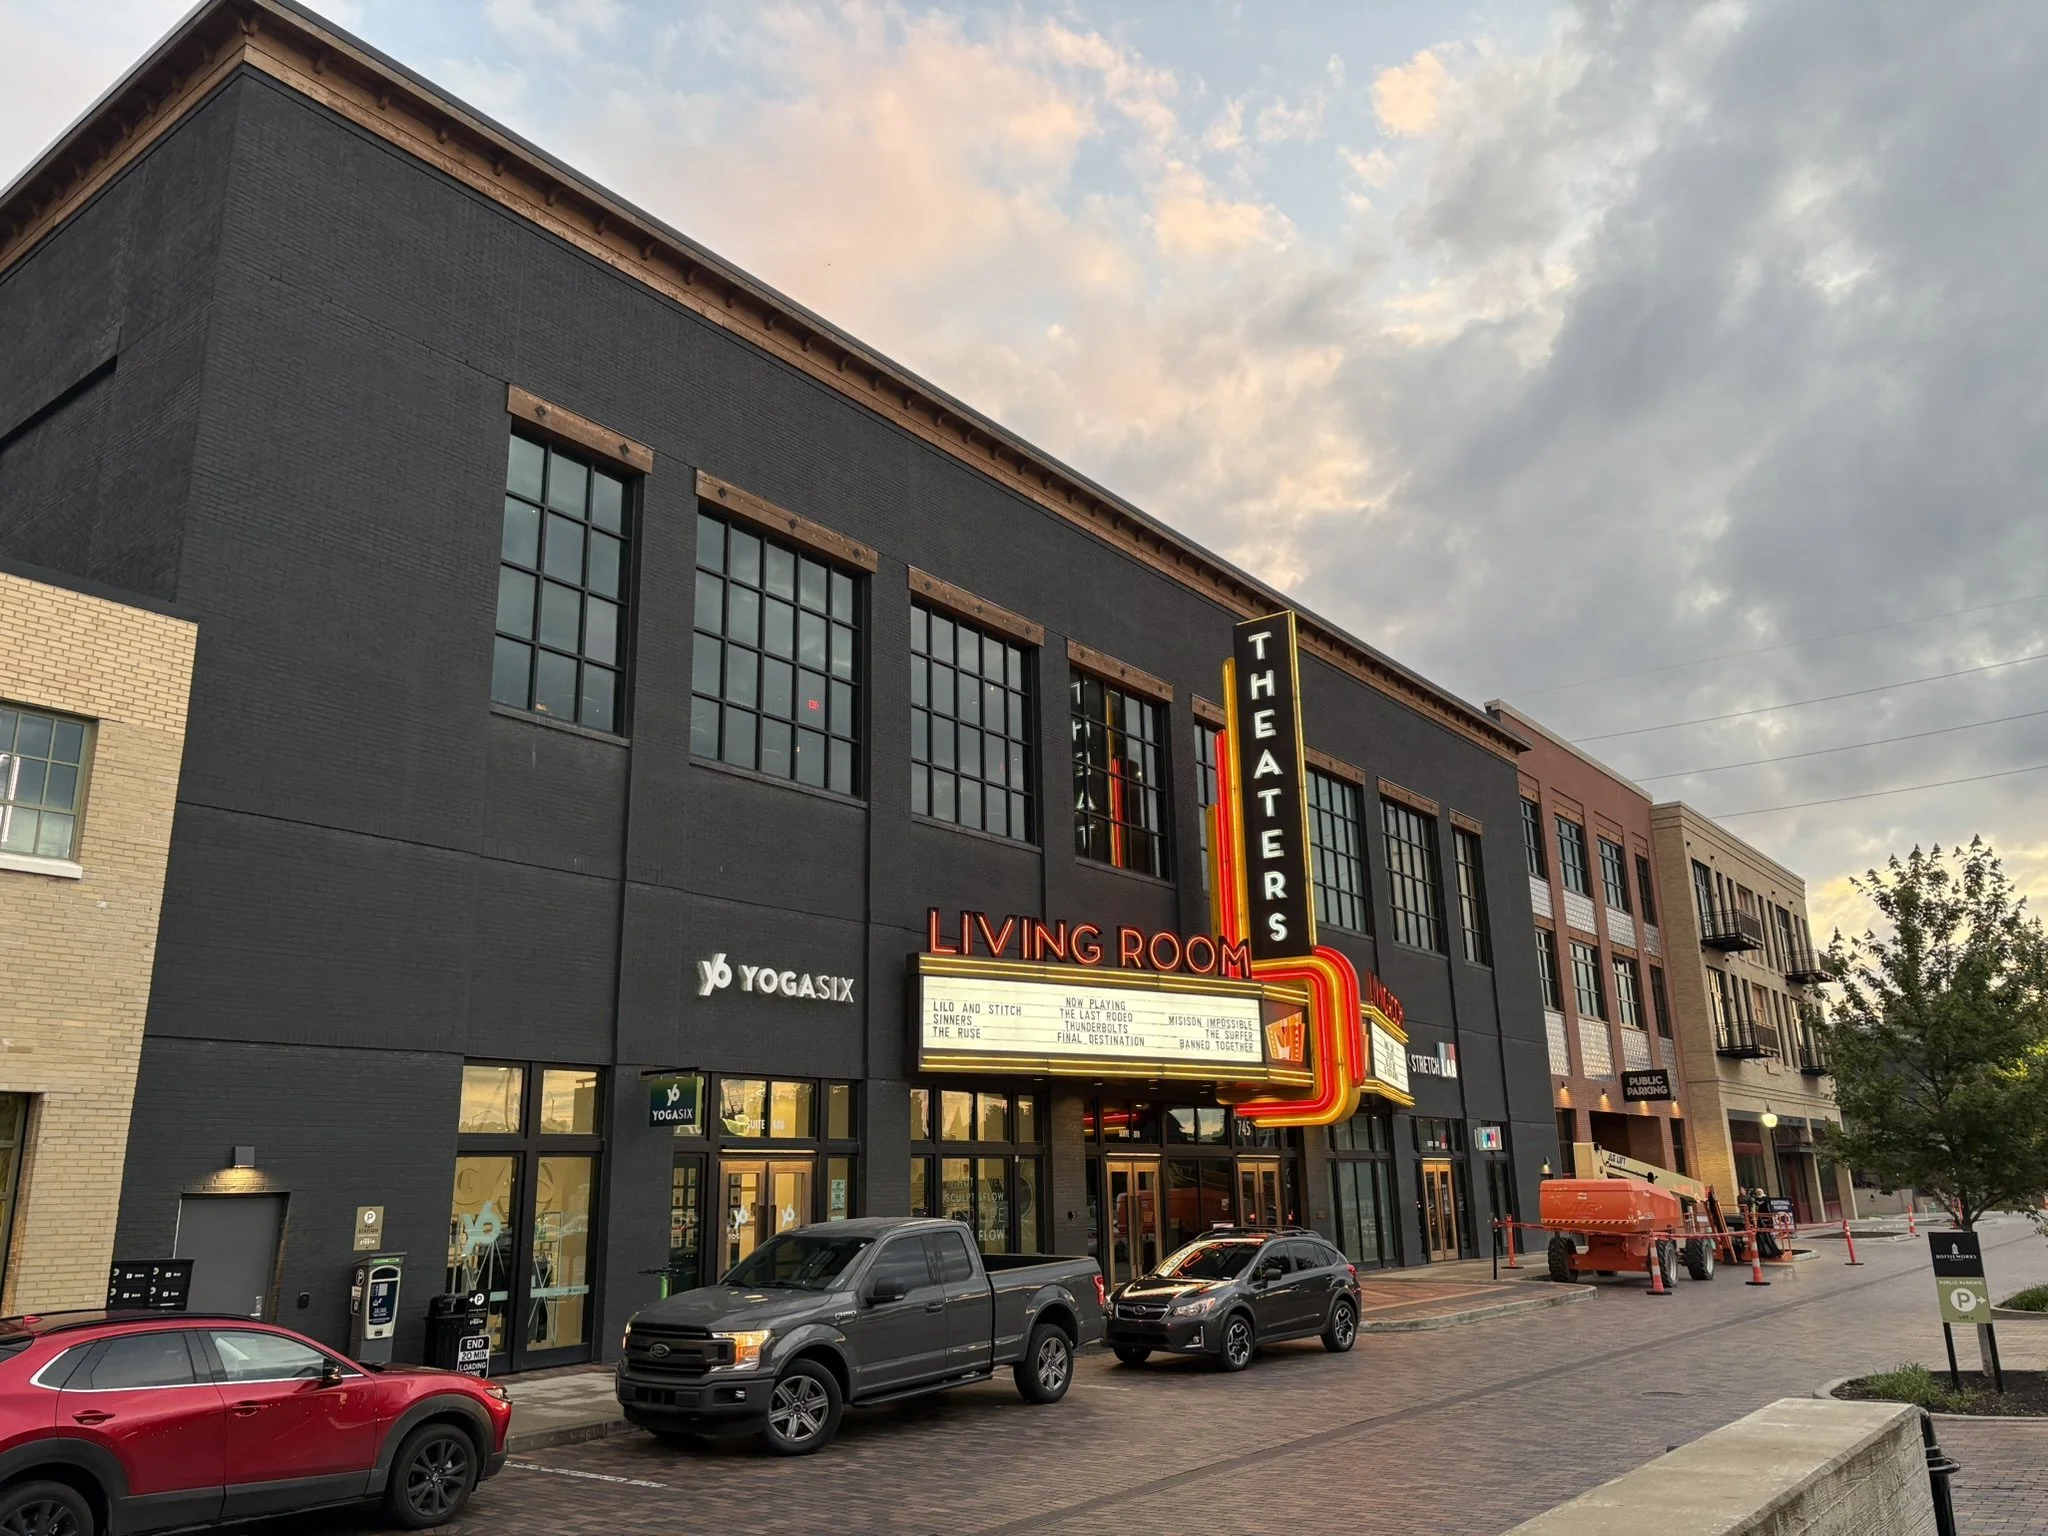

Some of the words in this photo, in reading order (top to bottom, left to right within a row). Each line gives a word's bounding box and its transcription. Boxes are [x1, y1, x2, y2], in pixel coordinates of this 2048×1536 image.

[1248, 631, 1288, 942] THEATERS
[927, 907, 1103, 966] LIVING
[1116, 925, 1252, 980] ROOM
[738, 964, 854, 1003] YOGASIX
[933, 1001, 954, 1013] LILO
[962, 1003, 981, 1015] AND
[988, 1004, 1022, 1017] STITCH
[1065, 997, 1084, 1009] NOW
[1089, 998, 1126, 1012] PLAYING
[933, 1013, 973, 1026] SINNERS
[1060, 1008, 1075, 1020] THE
[1079, 1010, 1100, 1021] LAST
[1106, 1011, 1133, 1023] RODEO
[1168, 1015, 1202, 1027] MISISON
[1206, 1018, 1253, 1030] IMPOSSIBLE
[933, 1026, 950, 1038] THE
[957, 1028, 981, 1039] RUSE
[1064, 1020, 1129, 1035] THUNDERBOLTS
[1205, 1028, 1220, 1039] THE
[1224, 1030, 1253, 1041] SURFER
[1057, 1032, 1082, 1043] FINAL
[1088, 1034, 1145, 1047] DESTINATION
[1179, 1039, 1210, 1050] BANNED
[1215, 1041, 1254, 1053] TOGETHER
[1409, 1054, 1440, 1075] STRETCH
[1629, 1076, 1663, 1086] PUBLIC
[1626, 1085, 1668, 1096] PARKING
[652, 1109, 693, 1121] YOGASIX
[1237, 1120, 1251, 1136] 745
[466, 1339, 484, 1350] END
[462, 1352, 472, 1361] 20
[474, 1350, 487, 1359] MIN
[460, 1361, 487, 1371] LOADING
